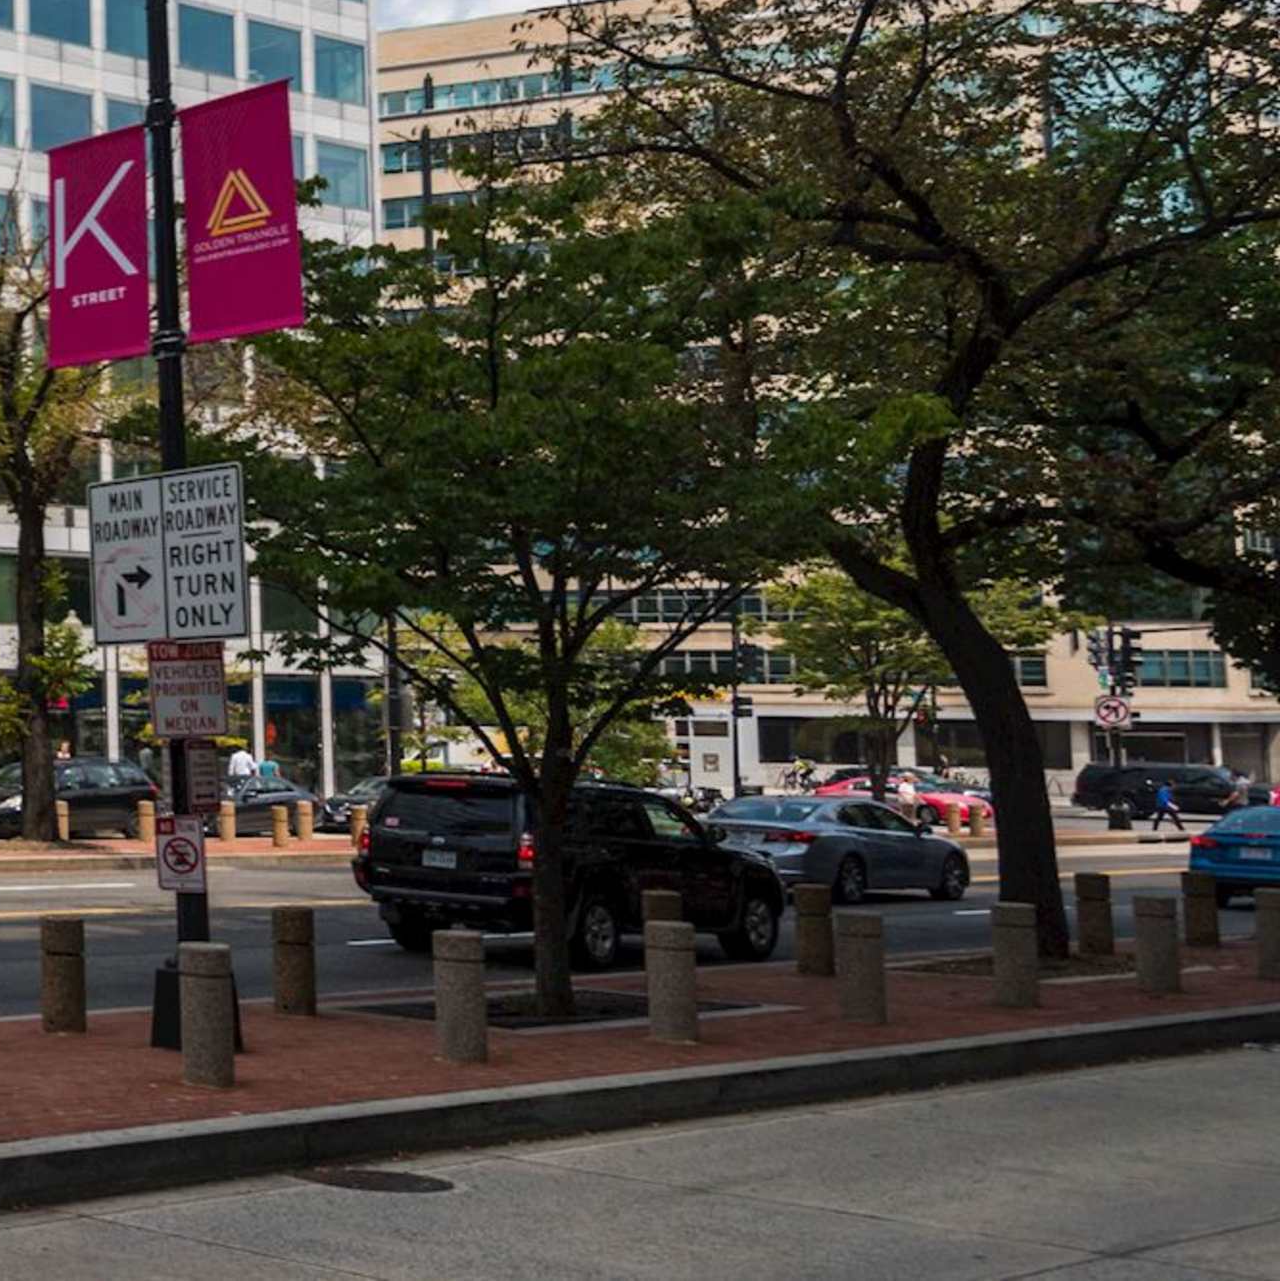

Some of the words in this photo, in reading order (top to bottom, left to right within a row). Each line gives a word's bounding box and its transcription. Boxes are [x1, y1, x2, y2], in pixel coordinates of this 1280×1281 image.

[54, 160, 139, 289] K
[192, 236, 236, 255] GOLDEN
[237, 222, 289, 243] TRIANGLE
[71, 286, 127, 308] STREET
[109, 489, 143, 513] MAIN
[168, 474, 232, 504] SERVICE
[95, 516, 159, 543] ROADWAY
[165, 502, 237, 531] ROADWAY
[169, 539, 235, 567] RIGHT
[174, 571, 235, 598] TURN
[175, 602, 235, 628] ONLY
[150, 643, 178, 660] TOW
[183, 642, 221, 659] ZONE
[154, 664, 219, 680] VEHICLES
[153, 681, 221, 696] PROHIBITED
[180, 699, 198, 713] ON
[164, 716, 217, 731] MEDIAN
